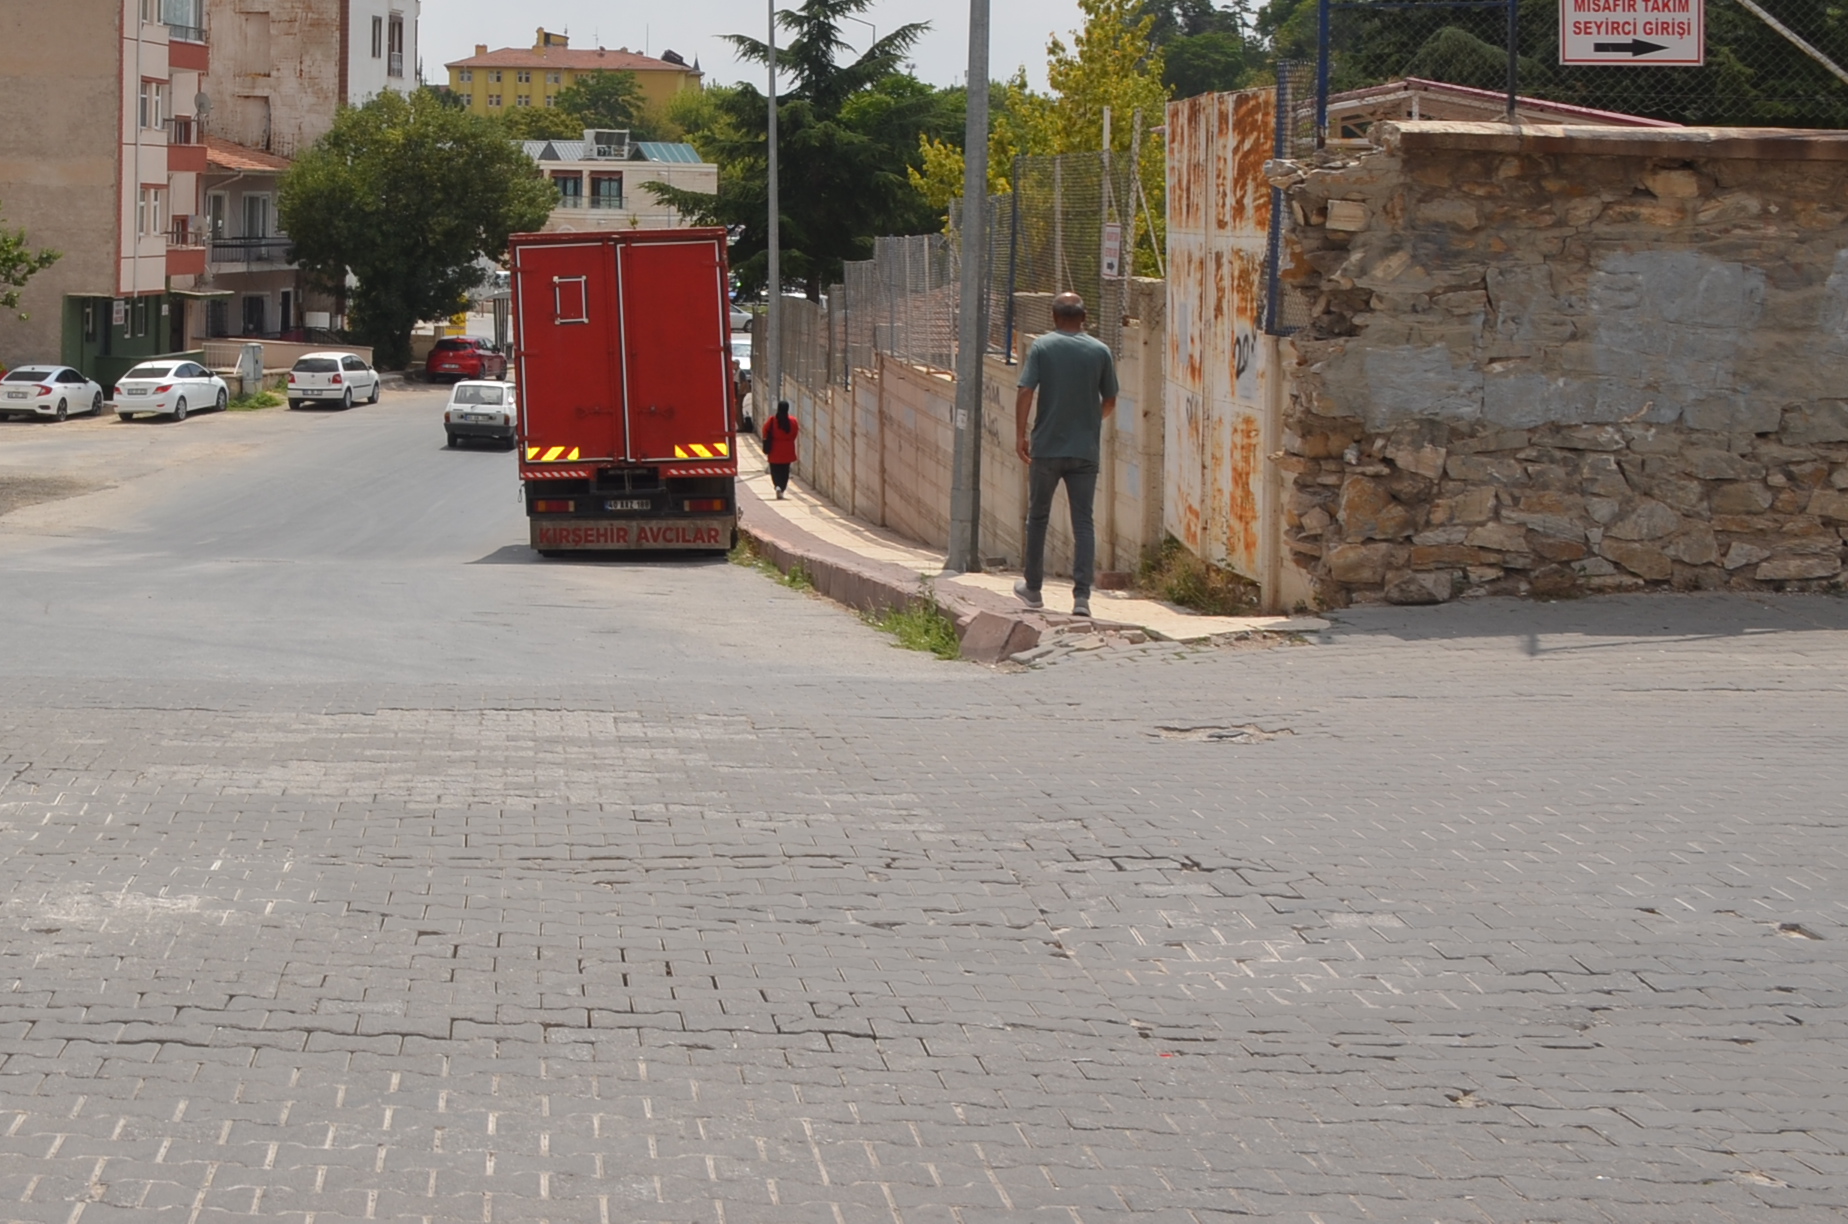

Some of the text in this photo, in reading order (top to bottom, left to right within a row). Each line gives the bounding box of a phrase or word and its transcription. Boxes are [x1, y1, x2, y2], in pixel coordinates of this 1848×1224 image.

[1573, 18, 1691, 39] SEYİRCİ GİRİŞİ
[539, 523, 719, 546] KIRŞEHİR AVCILAR
